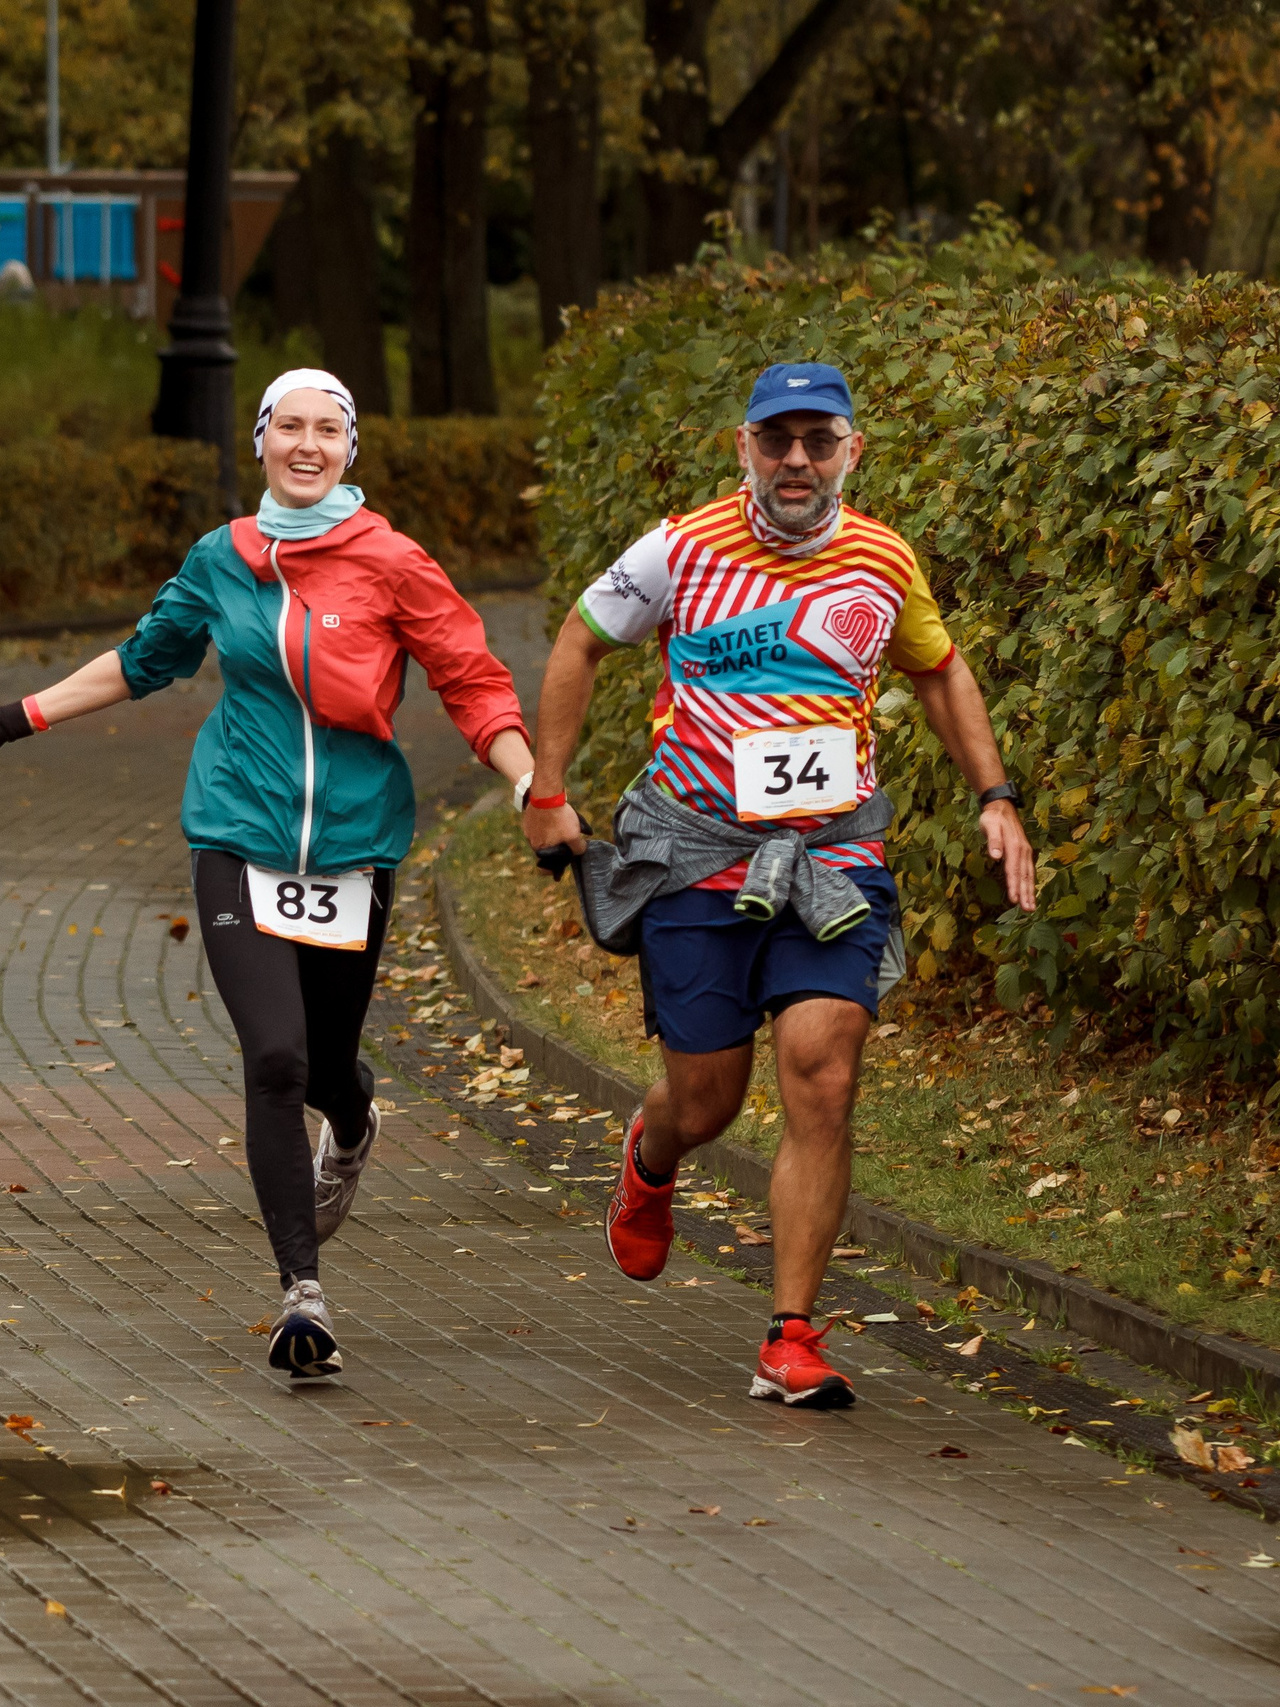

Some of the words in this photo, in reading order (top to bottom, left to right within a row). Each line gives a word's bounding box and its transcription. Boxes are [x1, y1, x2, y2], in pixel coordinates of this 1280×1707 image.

[708, 620, 784, 656] АТЛЕТ
[764, 751, 830, 796] 34
[276, 880, 339, 924] 83
